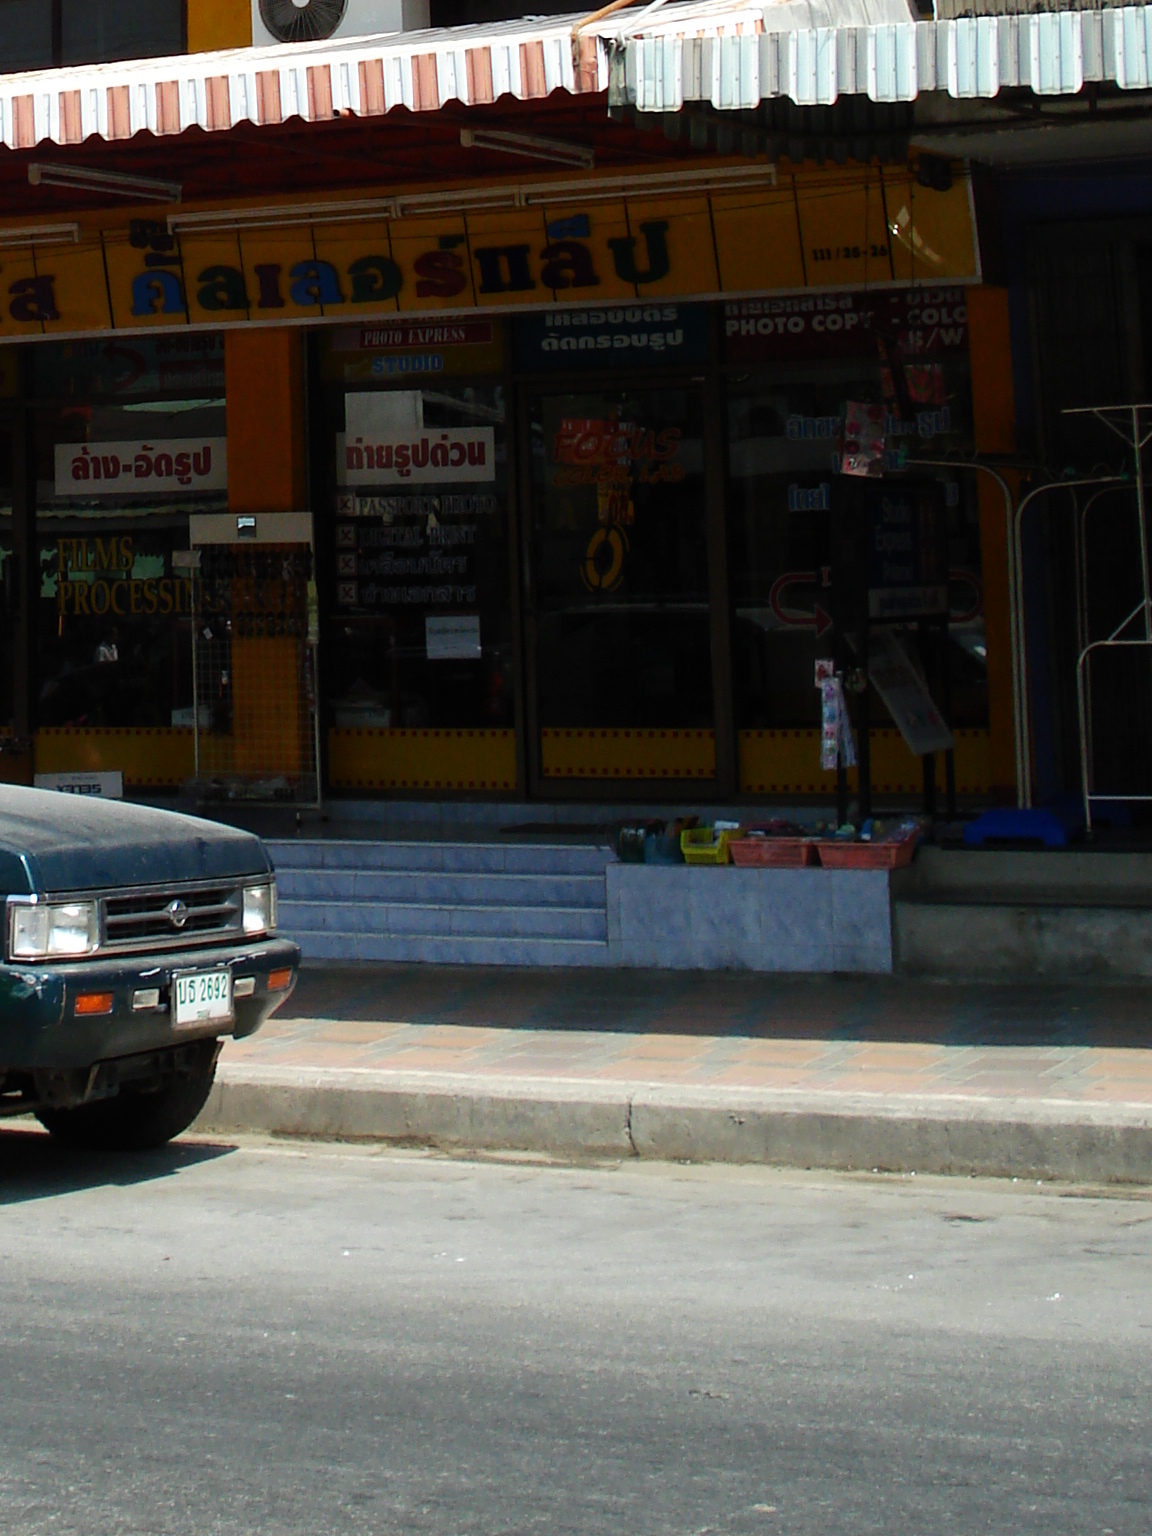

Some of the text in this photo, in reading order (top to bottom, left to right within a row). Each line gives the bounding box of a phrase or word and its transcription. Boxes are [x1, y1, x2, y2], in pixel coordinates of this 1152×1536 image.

[364, 326, 466, 346] PHOTO EXPRESS
[725, 316, 805, 337] PHOTO
[372, 353, 444, 374] STUDIO
[346, 433, 486, 477] ถ่ายรูปด่วน
[552, 427, 682, 463] FOCUS
[71, 446, 211, 485] ล้าง-อัดรูป
[640, 464, 686, 484] LAB
[358, 495, 435, 516] PASSPORT
[358, 524, 477, 546] DIGITAL PRINT
[57, 536, 134, 572] FILMS
[201, 975, 227, 1001] 2692
